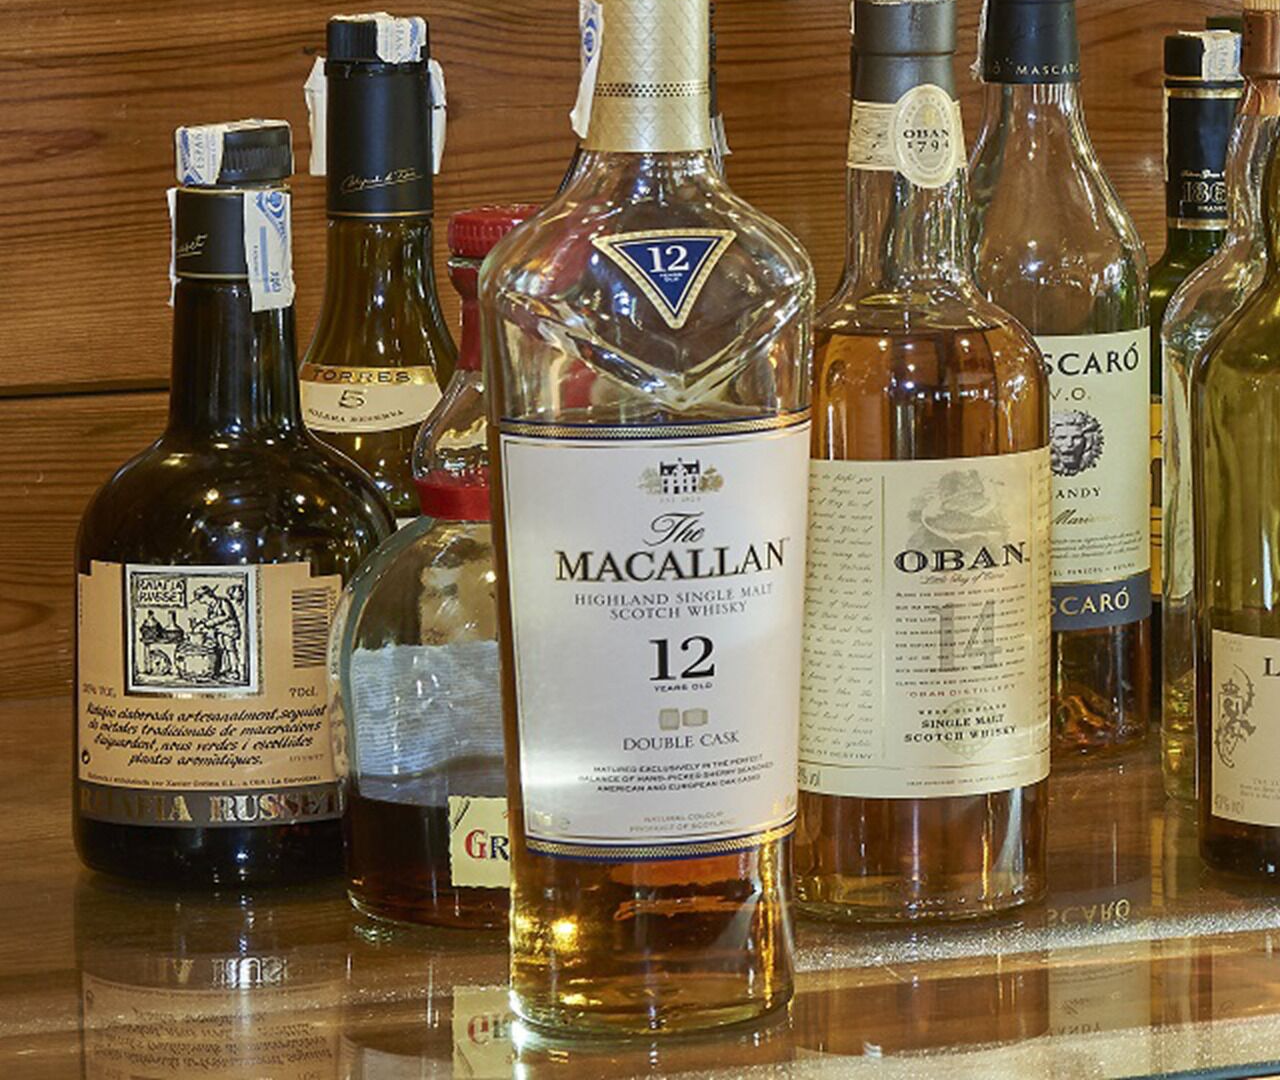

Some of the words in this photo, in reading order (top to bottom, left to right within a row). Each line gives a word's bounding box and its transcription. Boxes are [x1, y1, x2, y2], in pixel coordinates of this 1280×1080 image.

[647, 244, 691, 274] 12
[314, 369, 413, 385] TORRES
[337, 388, 367, 410] 5
[643, 510, 706, 548] The
[555, 537, 787, 582] MACALLAN
[893, 541, 1026, 574] OBAN
[574, 591, 670, 608] HIGHLAND
[676, 587, 736, 605] SINGLE
[741, 582, 774, 599] MALT
[609, 605, 681, 620] SCOTCH
[687, 600, 748, 617] WHISKY
[649, 635, 717, 682] 12
[692, 681, 714, 692] OLD
[904, 731, 964, 744] SCOTCH
[969, 725, 1017, 740] WHISKY
[922, 717, 972, 729] SINGLE
[623, 735, 696, 752] DOUBLE
[700, 730, 740, 747] CASK
[464, 828, 511, 861] GR
